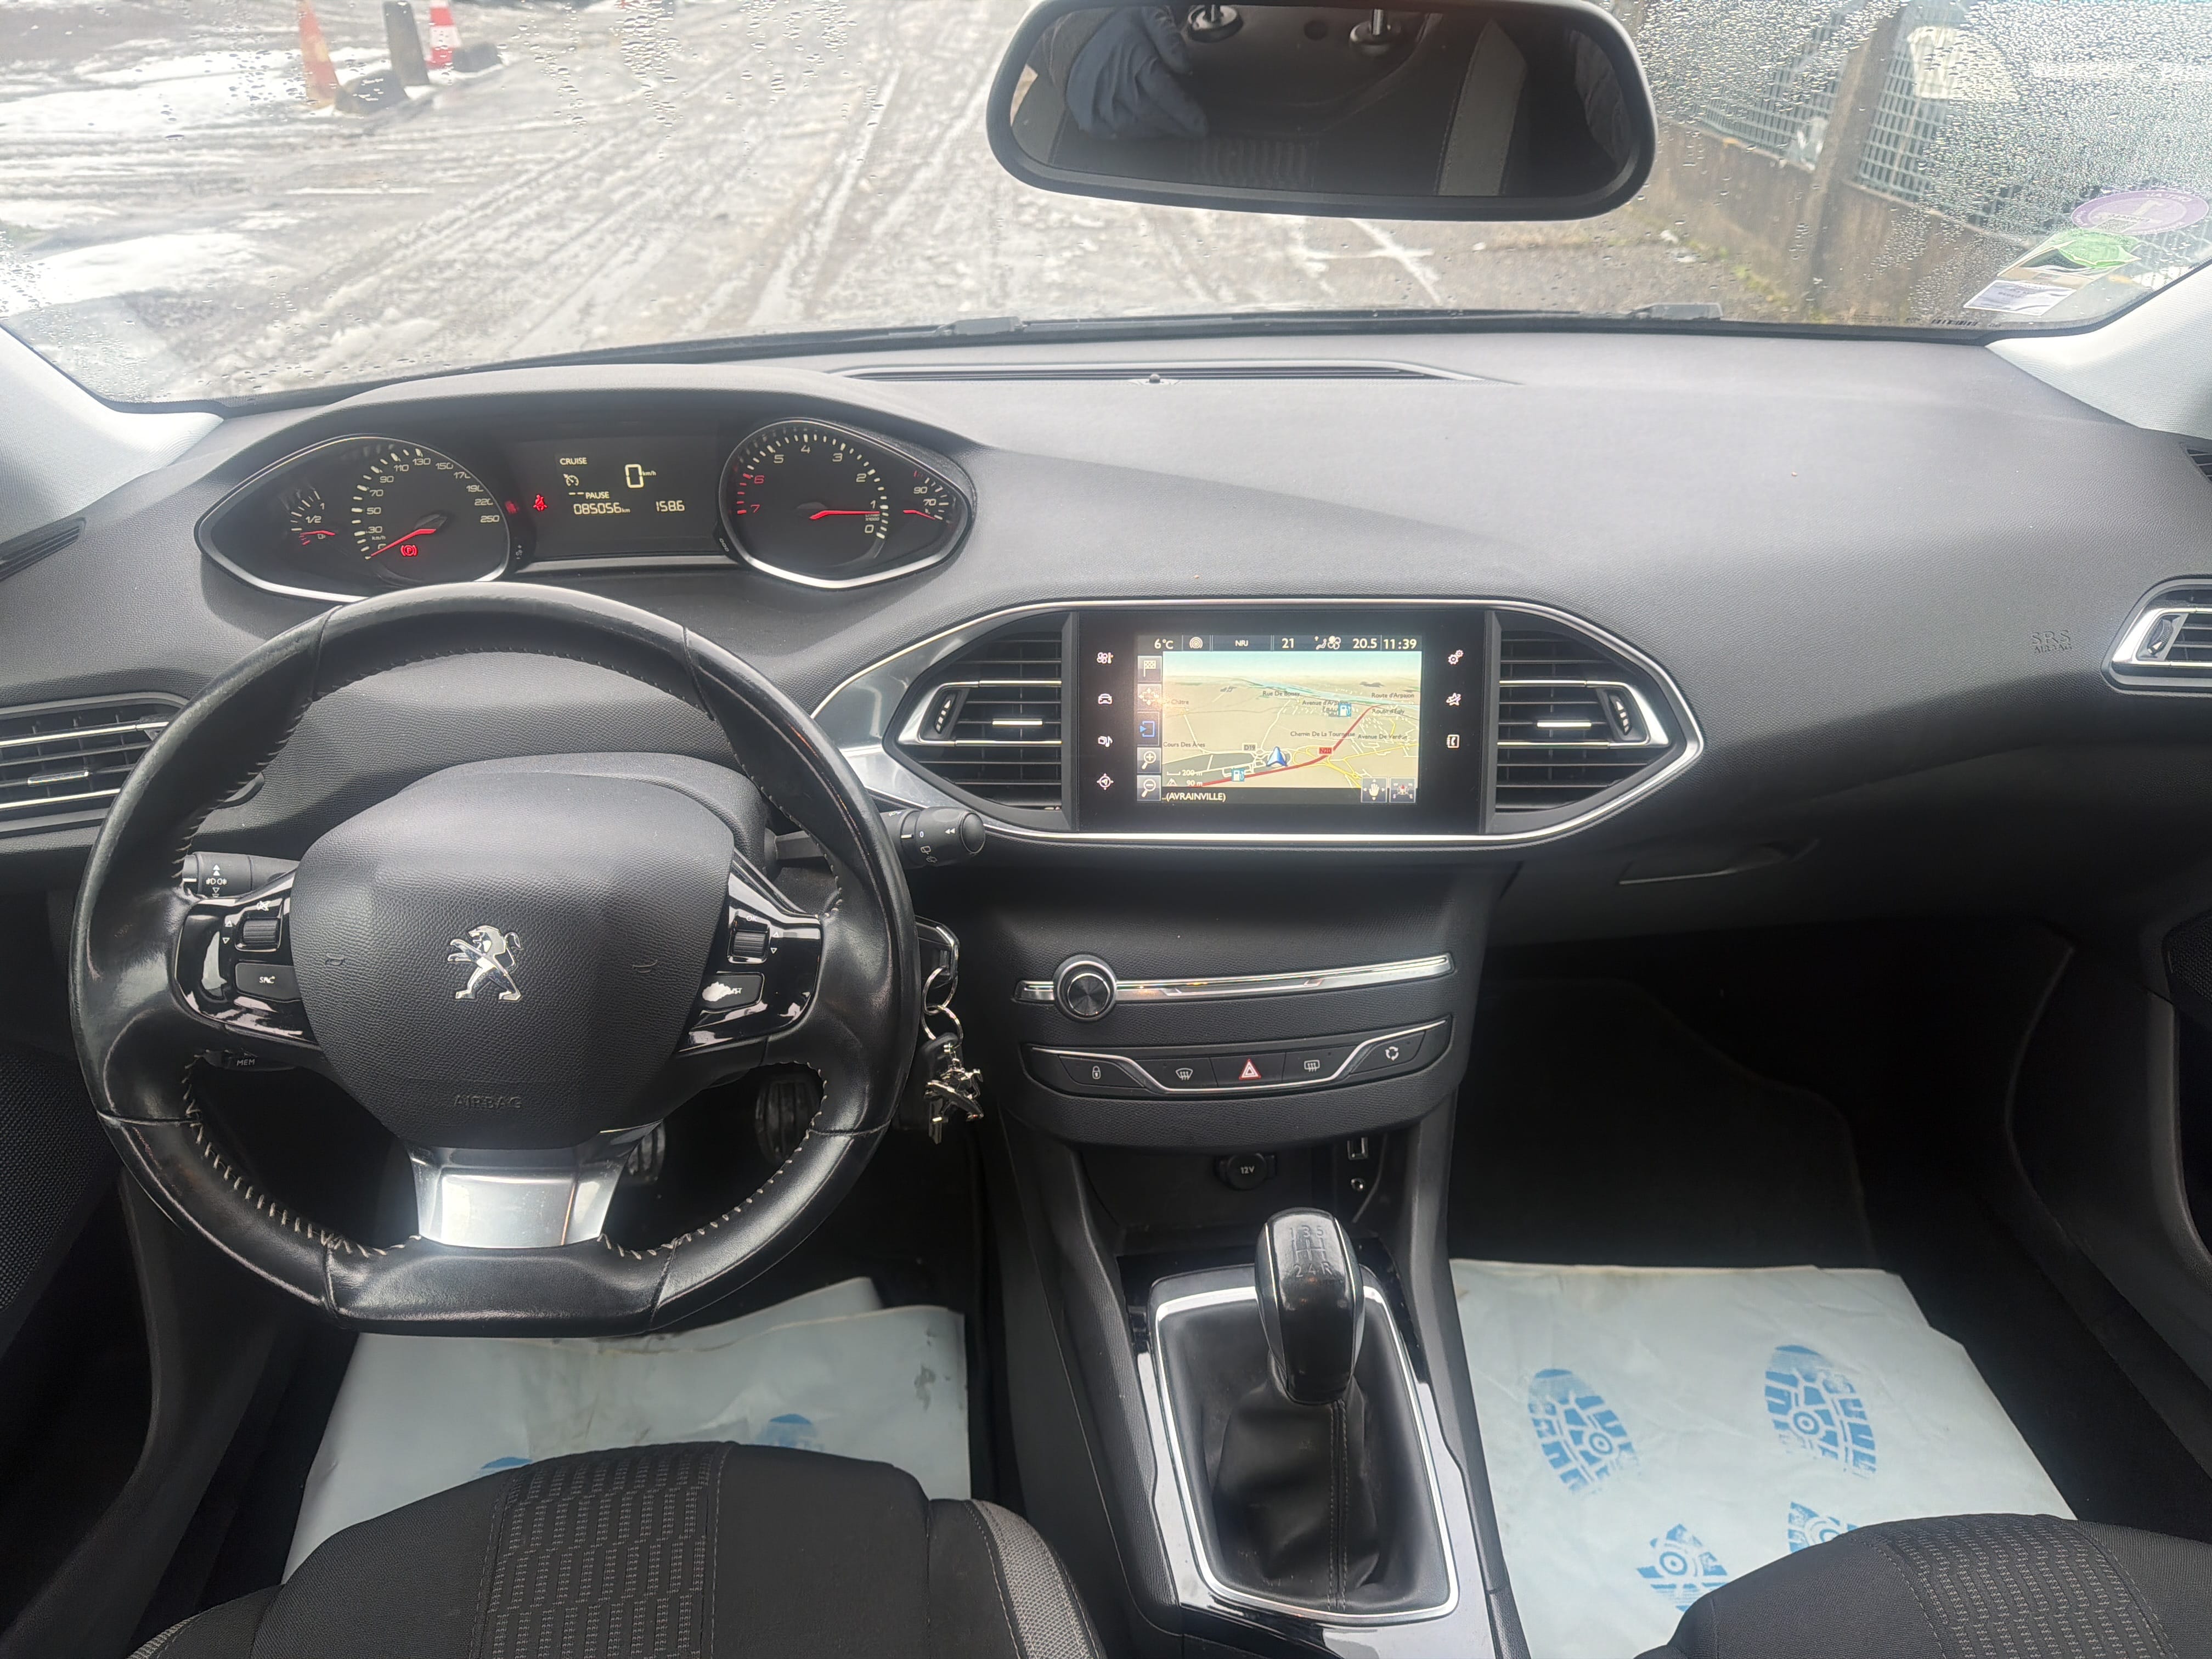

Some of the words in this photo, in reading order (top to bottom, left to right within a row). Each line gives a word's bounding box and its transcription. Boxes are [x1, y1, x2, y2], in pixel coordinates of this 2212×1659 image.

[800, 445, 811, 454] 4
[412, 458, 431, 466] 130
[560, 457, 588, 465] CRUISE
[774, 454, 785, 464] 5
[832, 453, 843, 462] 3
[435, 462, 454, 470] 150
[625, 464, 644, 488] 0
[754, 475, 765, 484] 6
[856, 473, 867, 482] 2
[369, 489, 384, 497] 70
[870, 500, 877, 509] 1
[923, 498, 936, 506] 70
[573, 502, 622, 515] 085056
[750, 504, 760, 513] 7
[305, 515, 322, 523] 1/2
[480, 515, 500, 523] 250
[865, 524, 874, 534] 0
[2032, 630, 2071, 645] SRS
[1154, 639, 1173, 650] 6°C
[1282, 637, 1295, 648] 21
[1352, 637, 1378, 649] 20.5
[1383, 639, 1417, 650] 11:39
[236, 1058, 256, 1067] MEM
[1240, 1166, 1255, 1174] 12V
[1301, 1224, 1311, 1238] 3
[1293, 1263, 1304, 1278] 2
[1321, 1261, 1333, 1276] R
